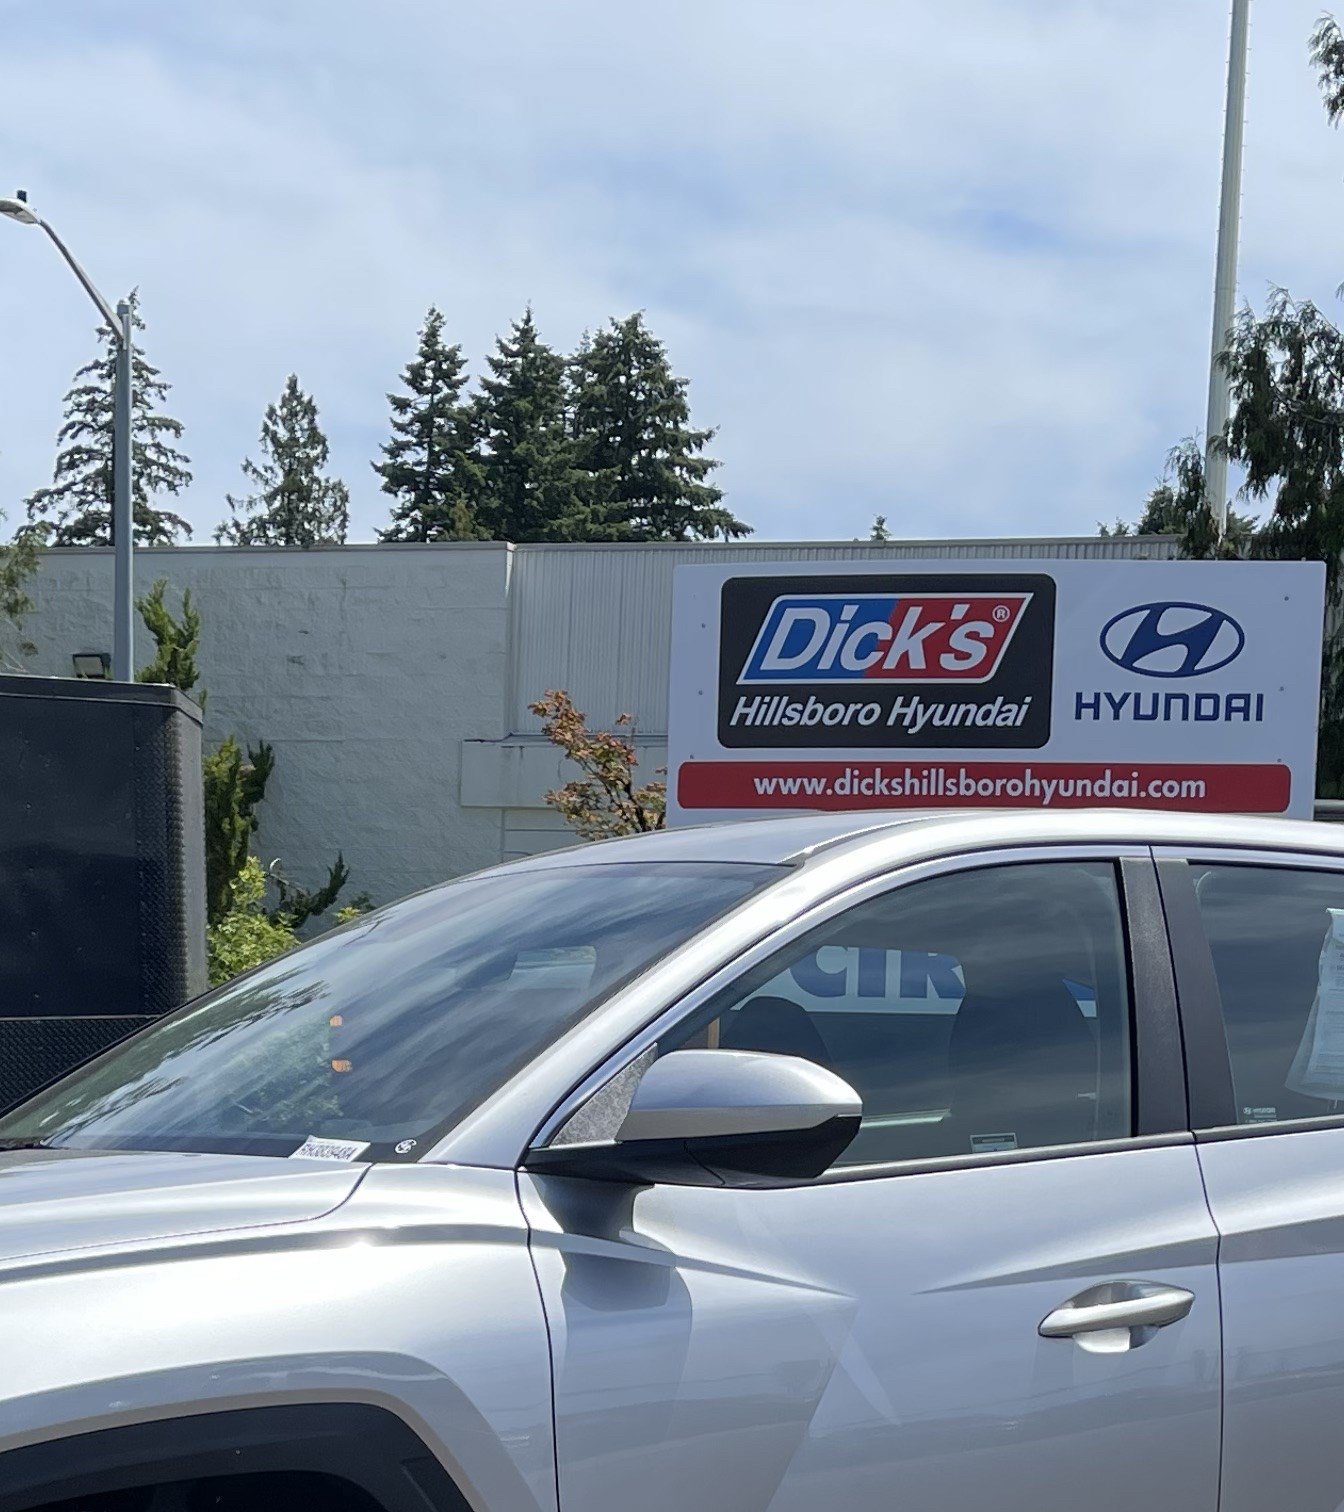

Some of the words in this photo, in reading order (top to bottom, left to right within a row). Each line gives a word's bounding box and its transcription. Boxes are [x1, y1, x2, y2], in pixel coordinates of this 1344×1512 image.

[759, 603, 994, 671] Dick's
[729, 696, 881, 727] Hillsboro
[886, 695, 1033, 734] Hyundai
[1074, 691, 1265, 723] HYUNDAI
[753, 768, 1207, 805] www.dickshillsborohyundai.com
